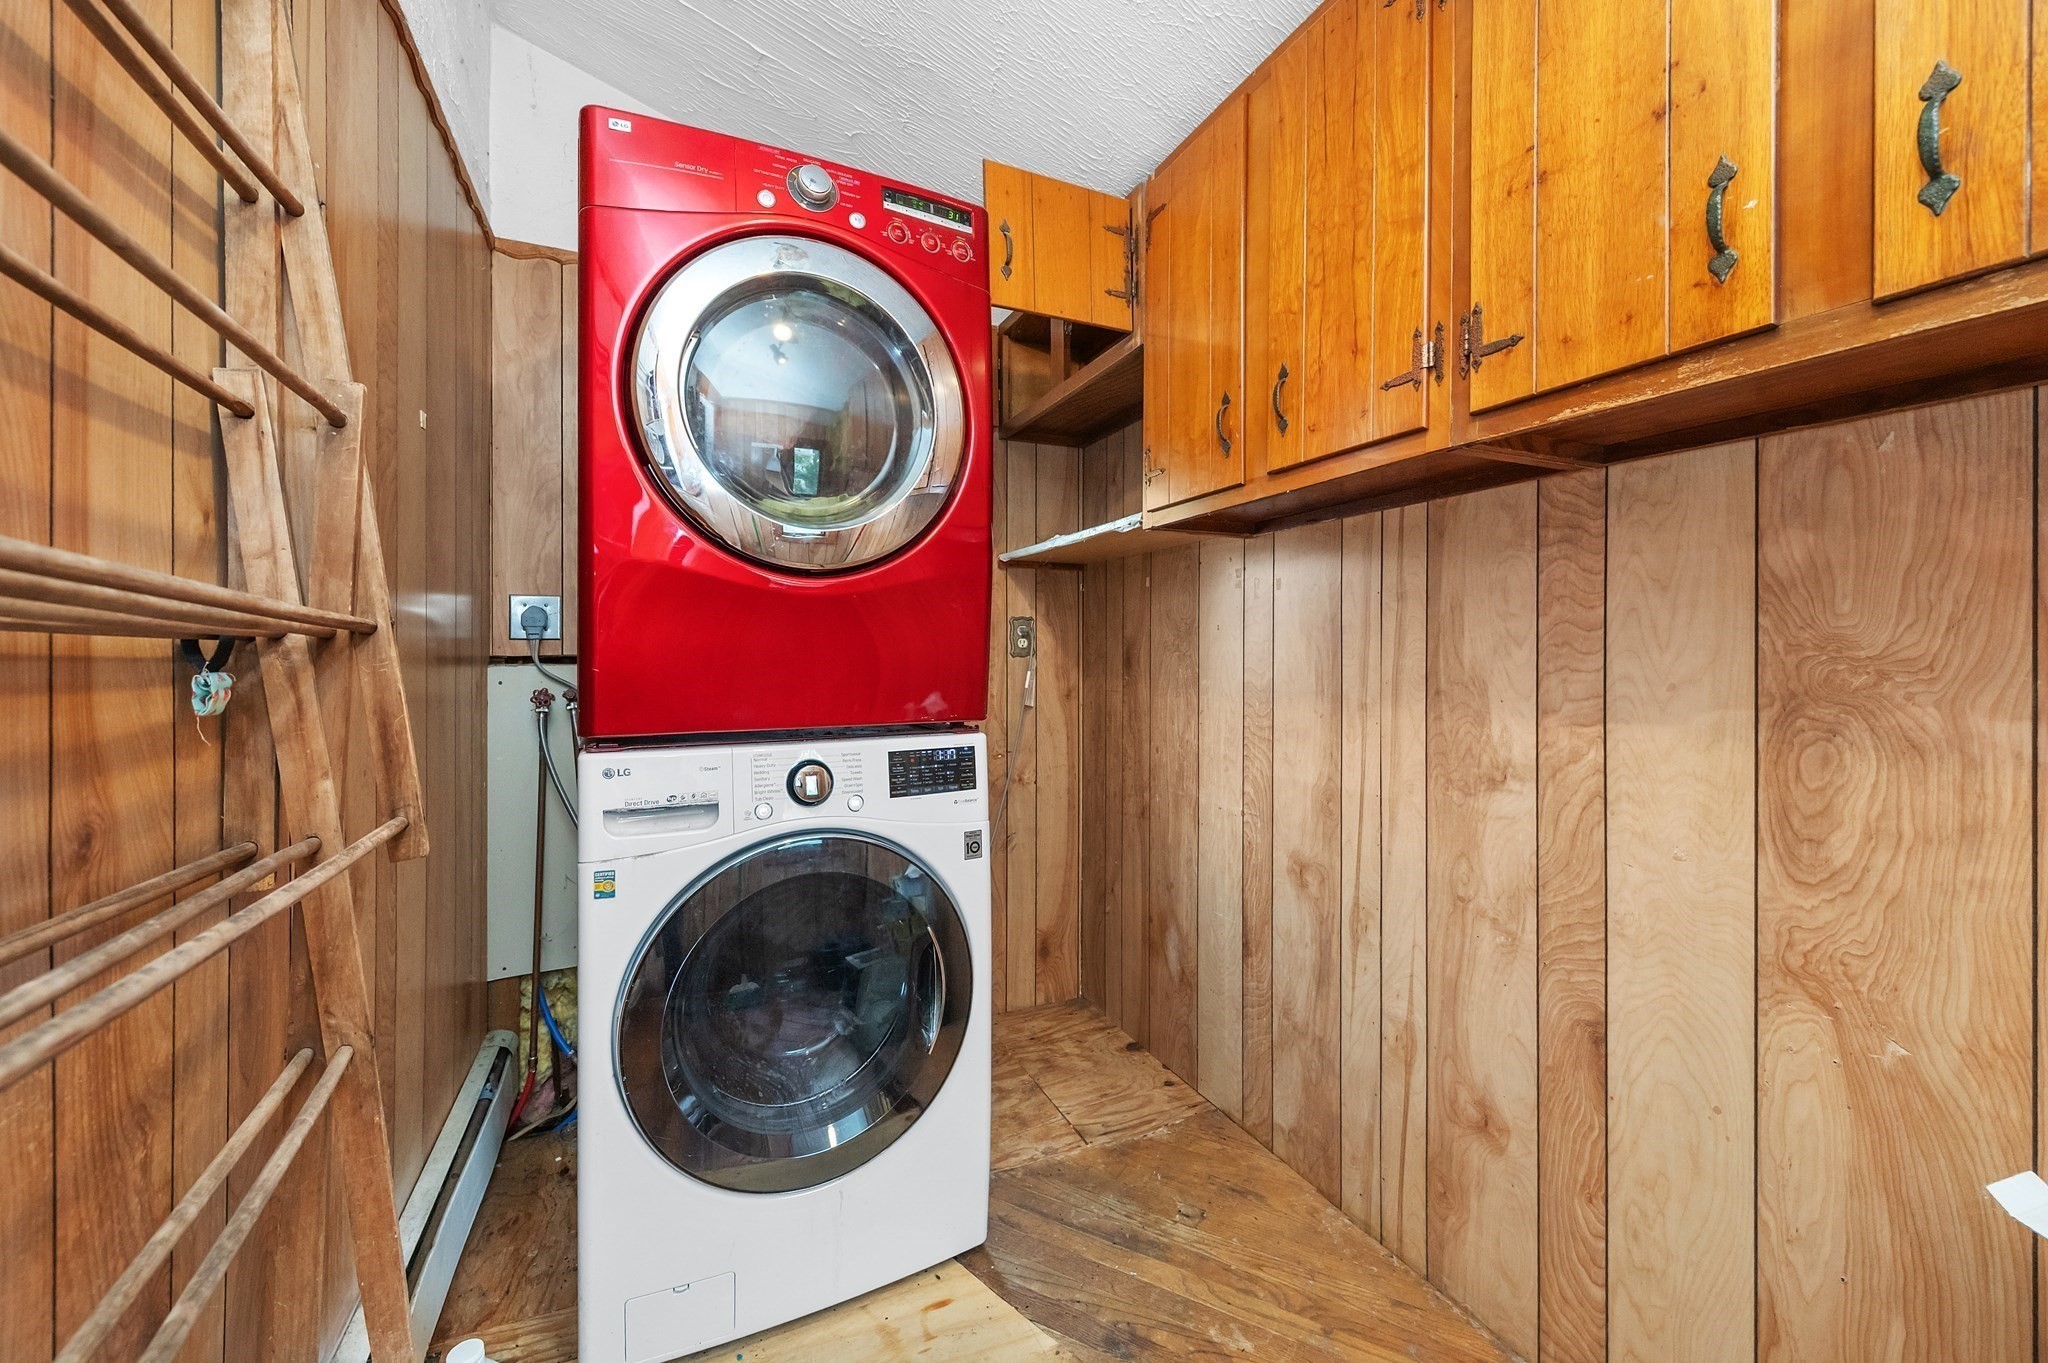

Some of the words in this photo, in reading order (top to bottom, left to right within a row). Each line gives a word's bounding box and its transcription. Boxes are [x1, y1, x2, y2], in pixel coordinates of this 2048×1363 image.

[674, 161, 696, 171] Sensor
[697, 165, 709, 173] Dry
[948, 210, 960, 221] 31
[617, 768, 631, 777] LG
[966, 841, 981, 855] 10
